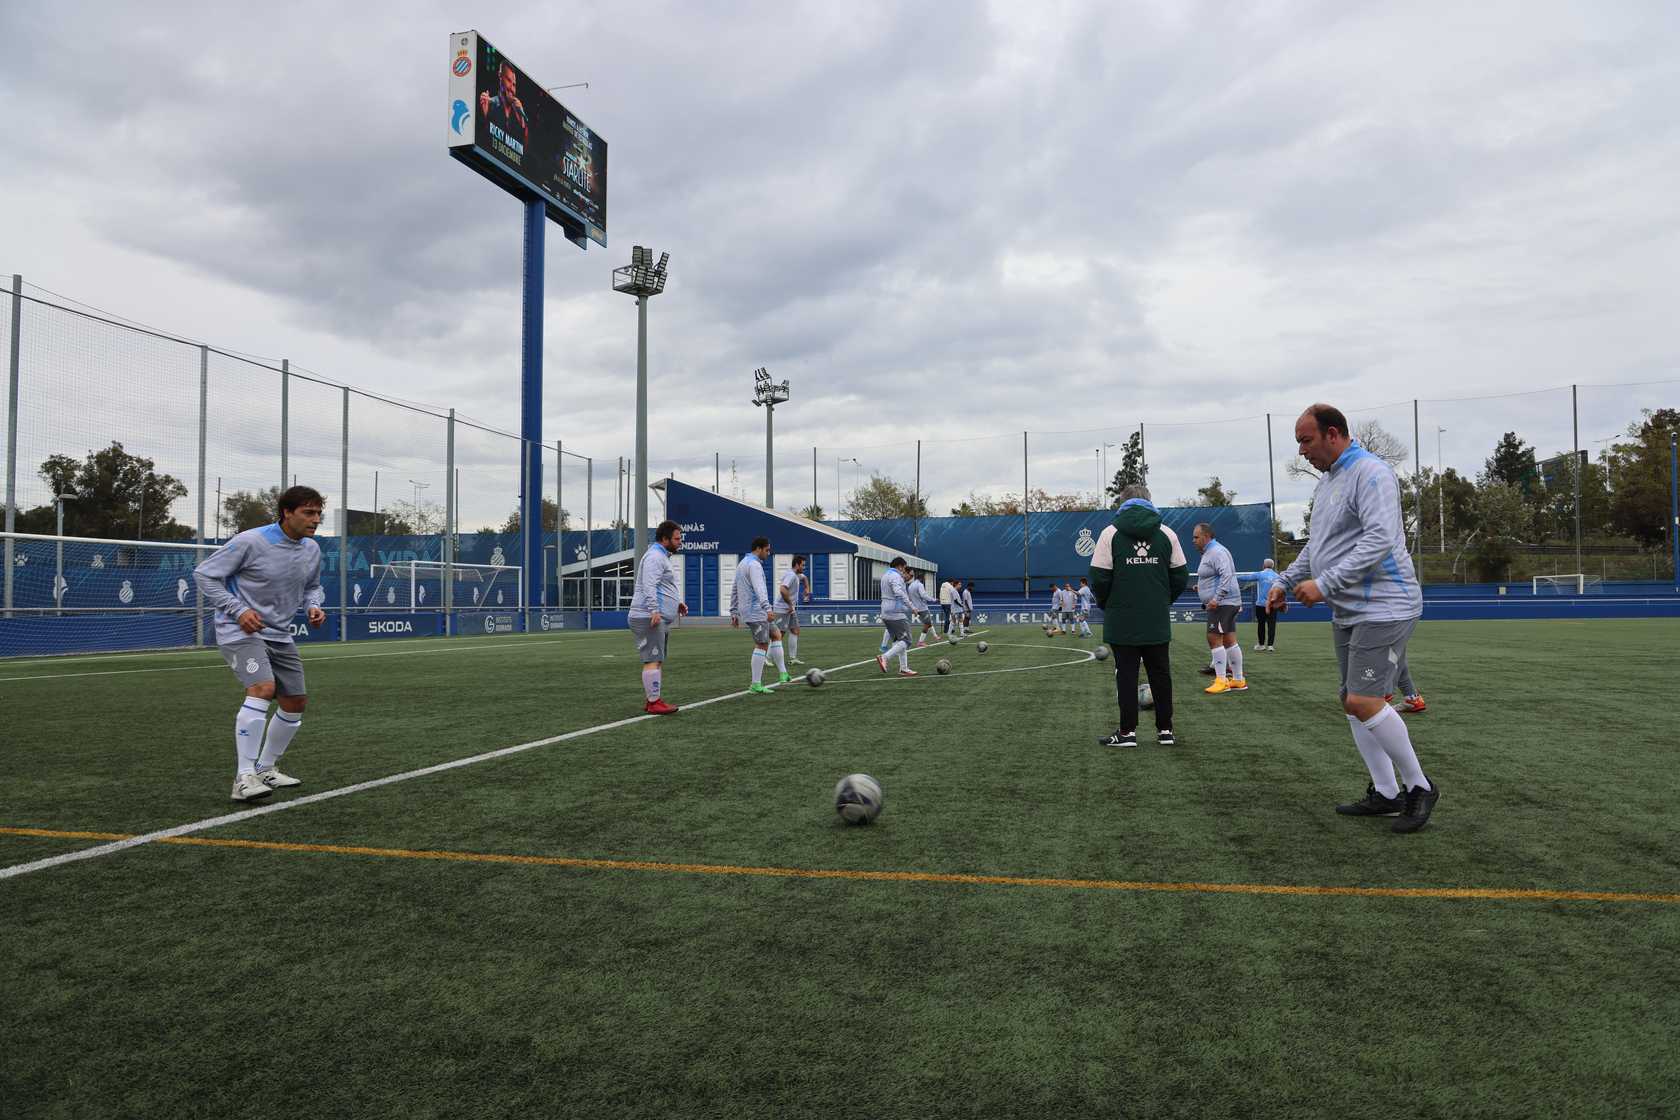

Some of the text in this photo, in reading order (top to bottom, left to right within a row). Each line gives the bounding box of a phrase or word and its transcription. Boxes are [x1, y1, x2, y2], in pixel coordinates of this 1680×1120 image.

[489, 121, 524, 156] RICKY MARTIN
[563, 156, 593, 193] STARLITE
[1126, 557, 1159, 565] KELME
[810, 613, 869, 624] KELME
